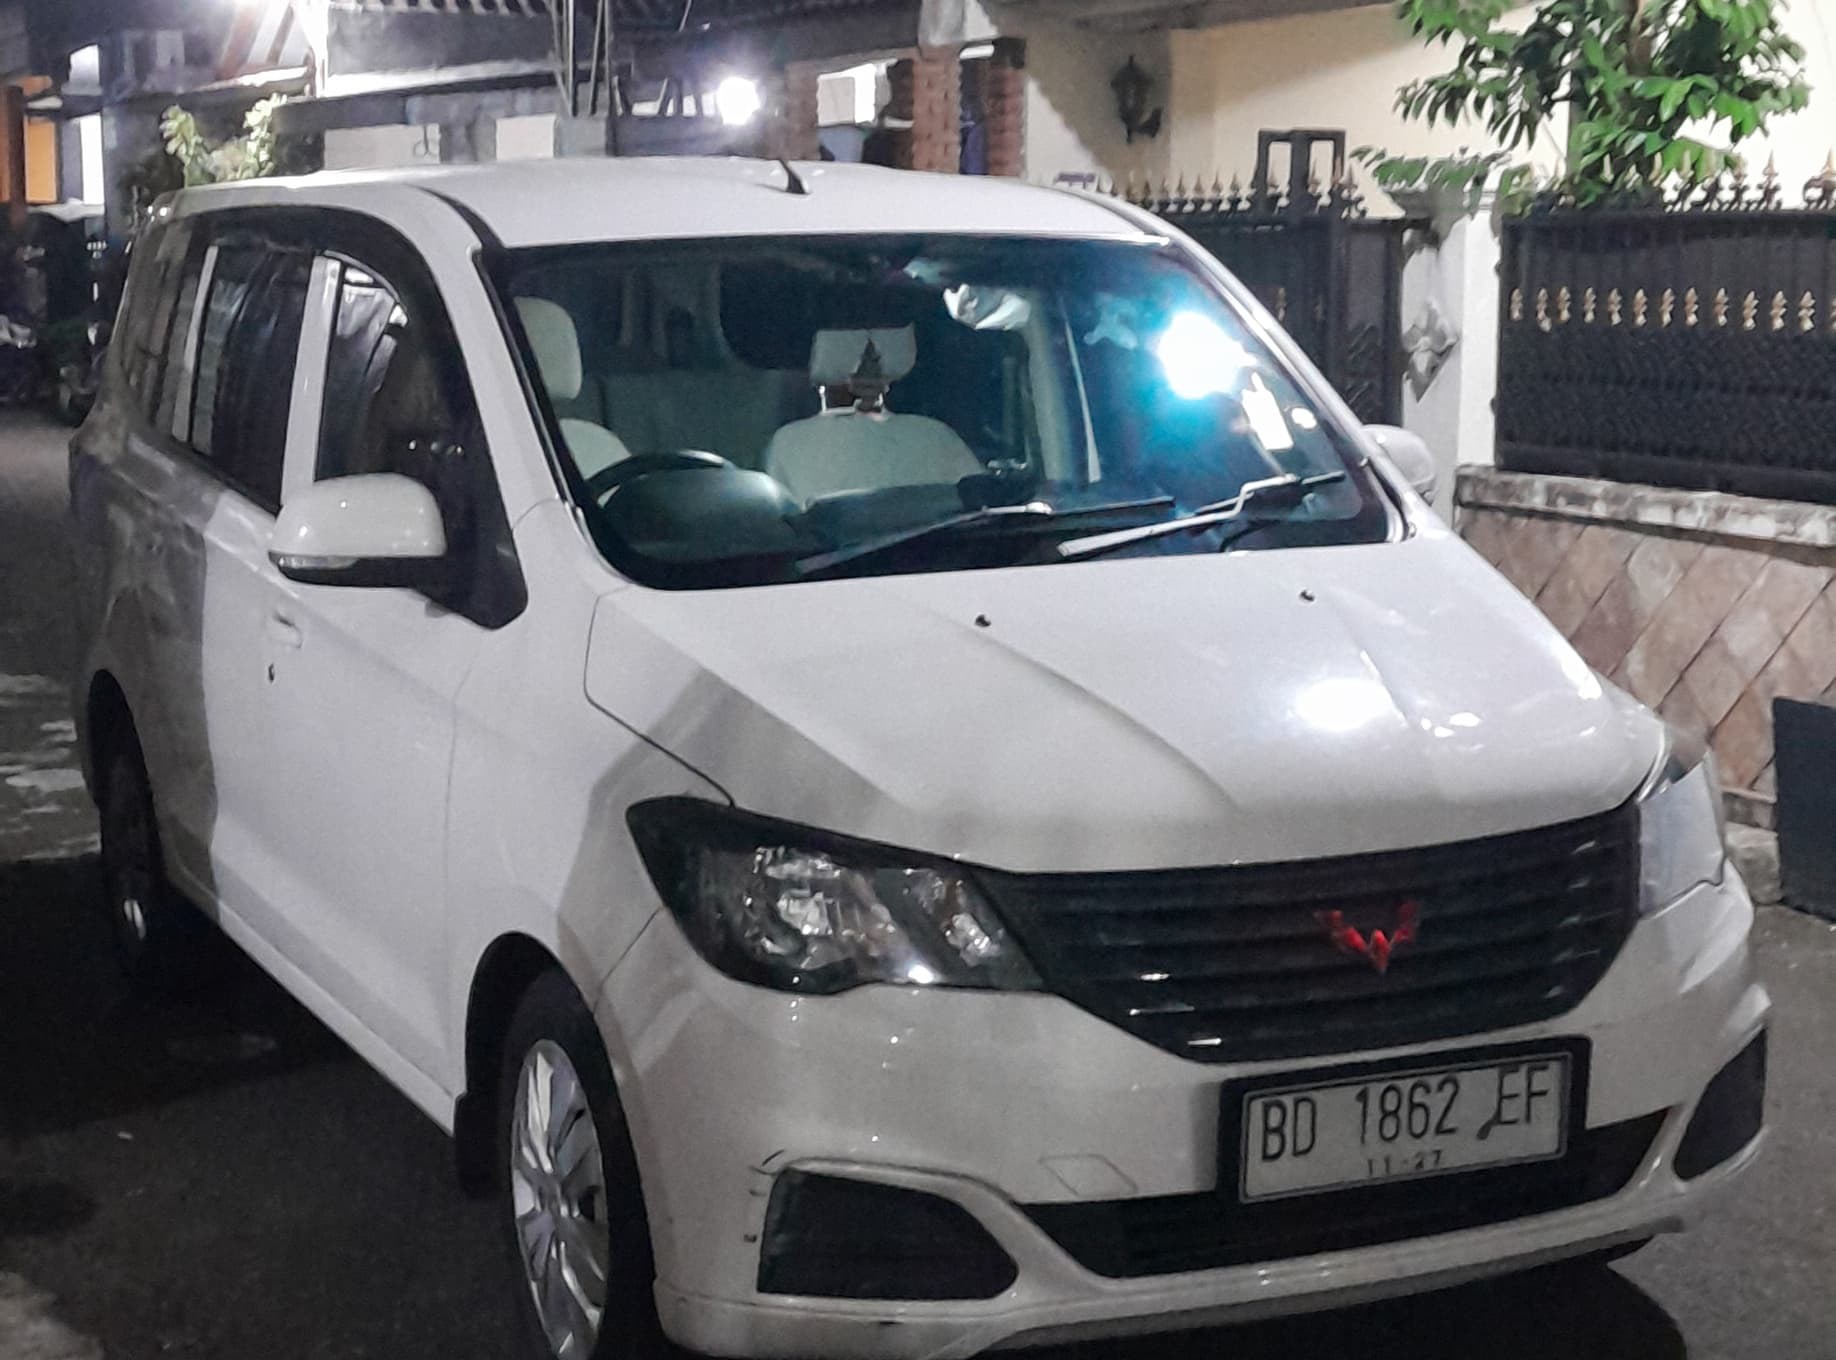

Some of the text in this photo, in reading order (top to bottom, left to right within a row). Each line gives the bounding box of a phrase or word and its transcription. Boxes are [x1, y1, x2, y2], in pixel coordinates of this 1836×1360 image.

[1261, 1064, 1549, 1162] BD 1862 EF
